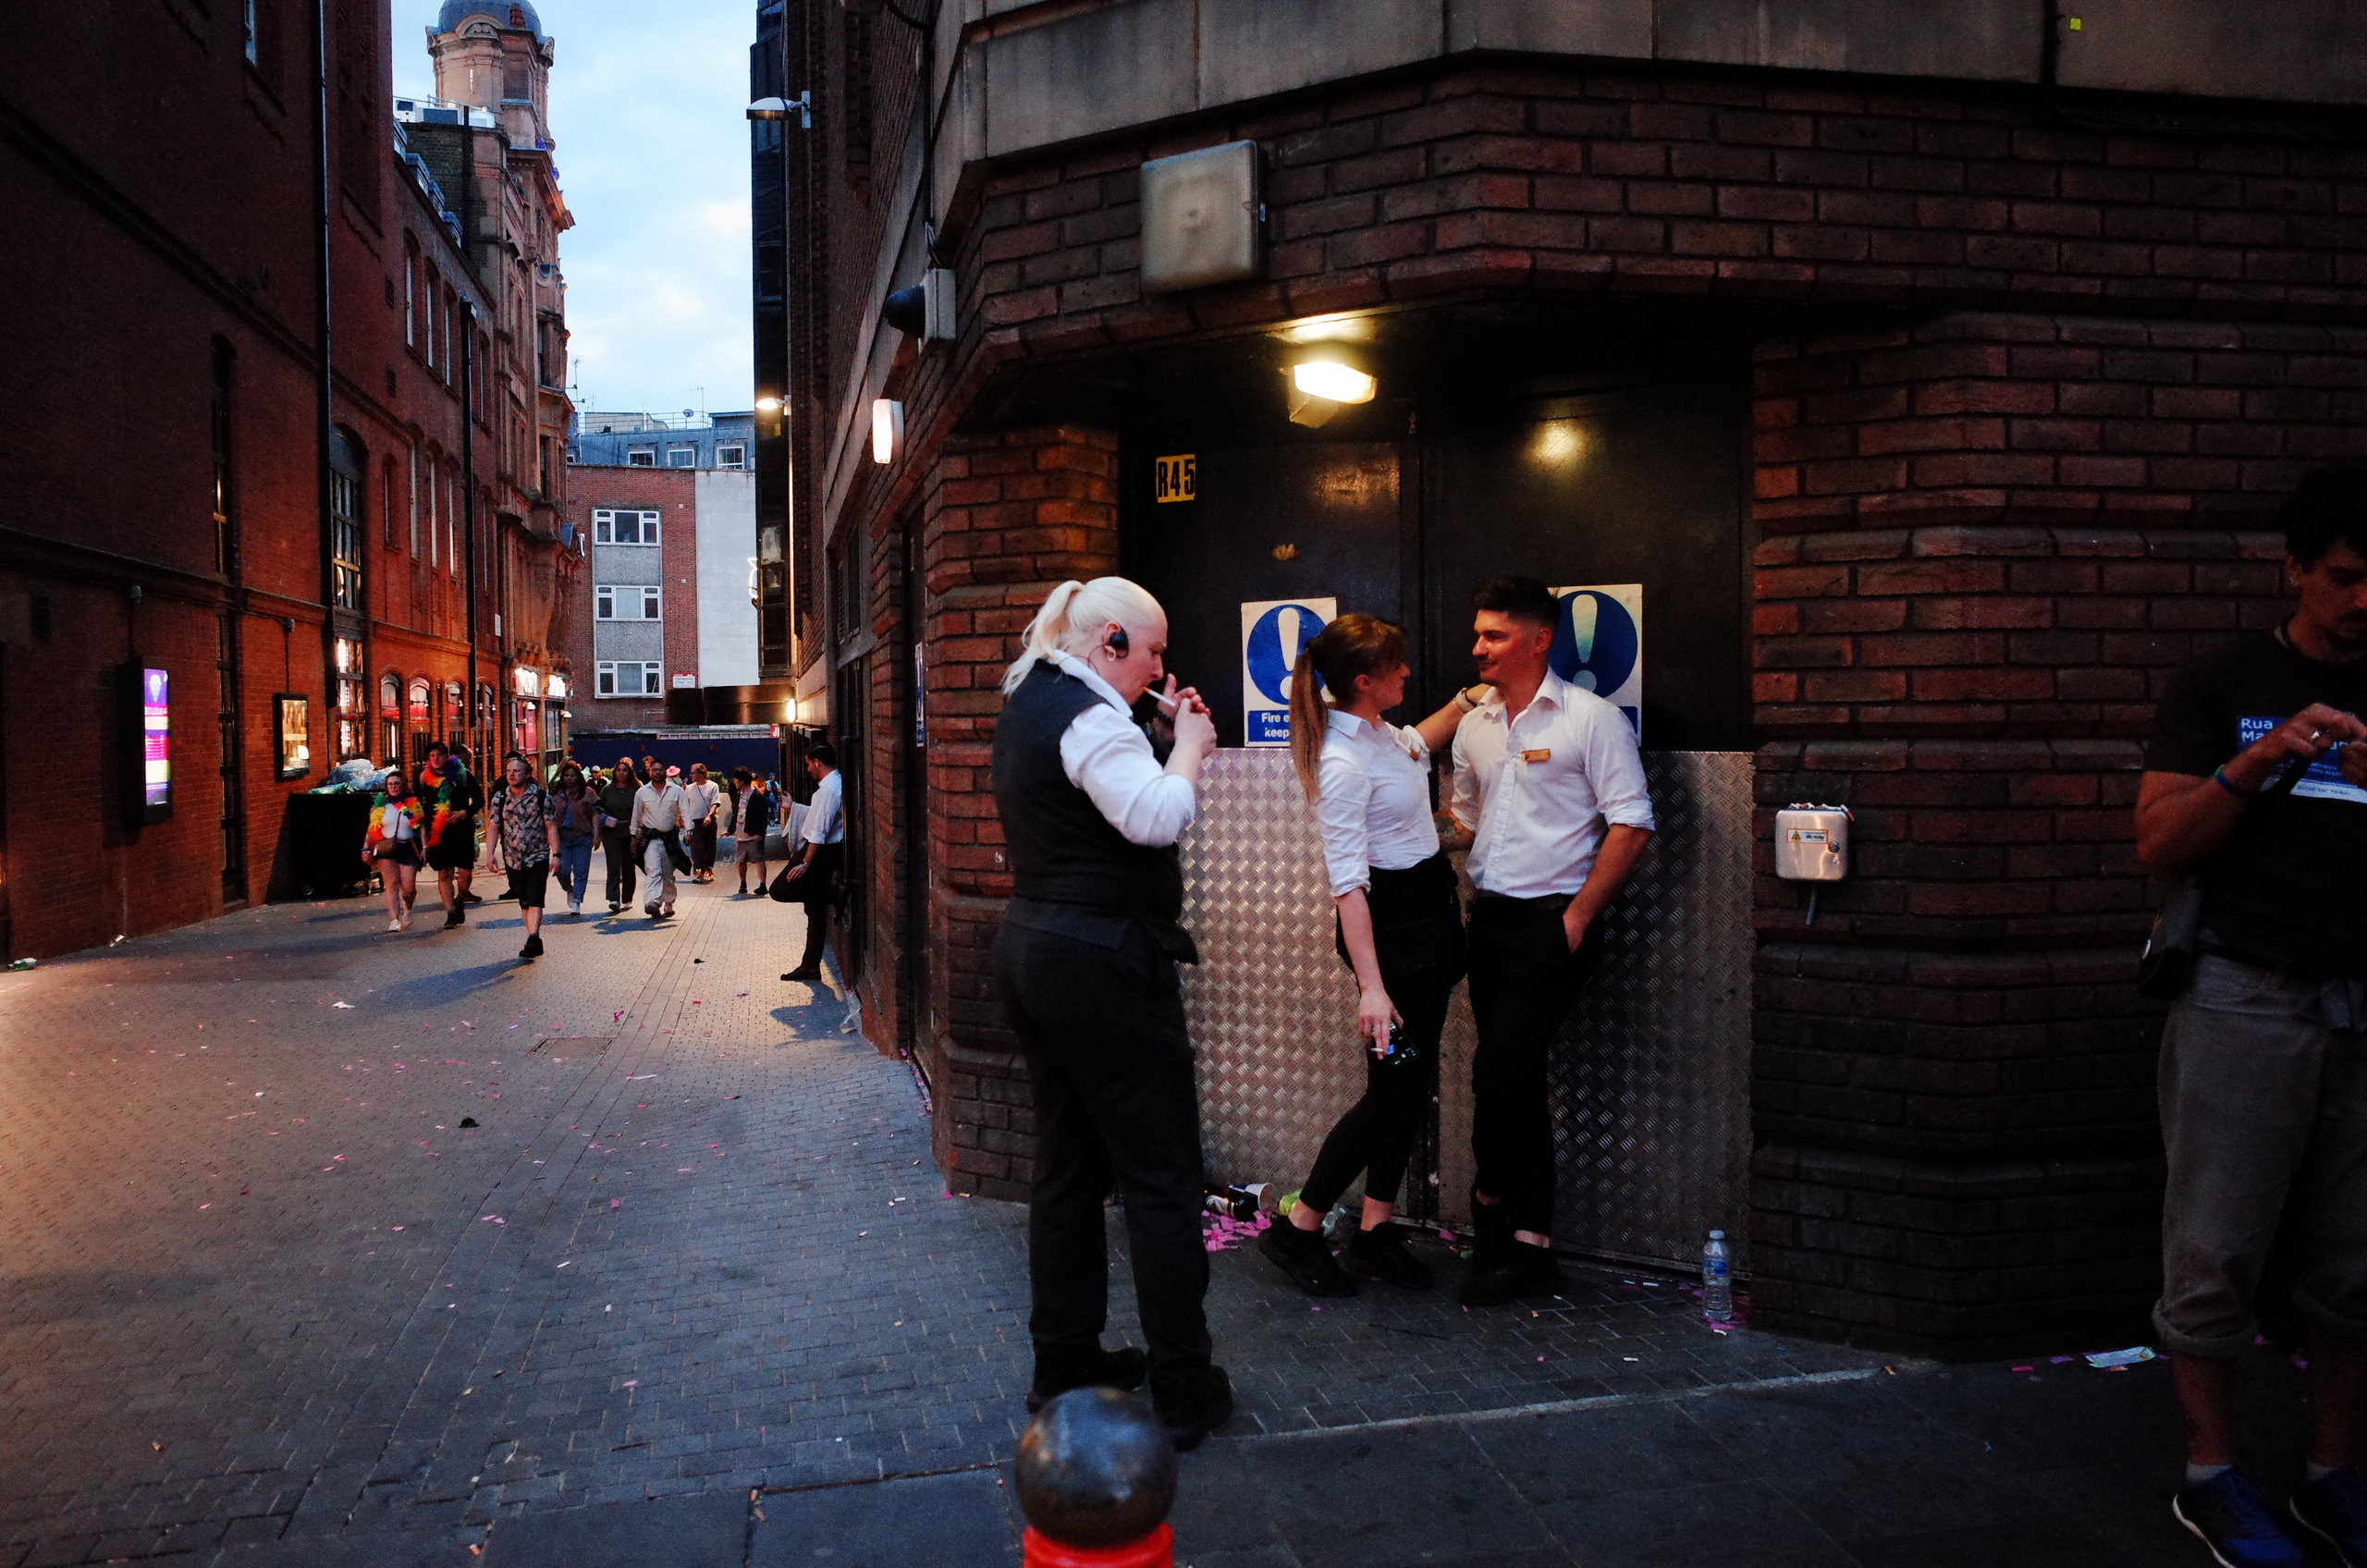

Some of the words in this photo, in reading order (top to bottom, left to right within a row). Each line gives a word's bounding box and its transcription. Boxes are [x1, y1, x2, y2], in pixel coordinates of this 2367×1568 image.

[1158, 459, 1195, 497] R45
[1260, 712, 1282, 723] Fire
[2240, 717, 2274, 729] Rua
[1264, 727, 1290, 740] keep
